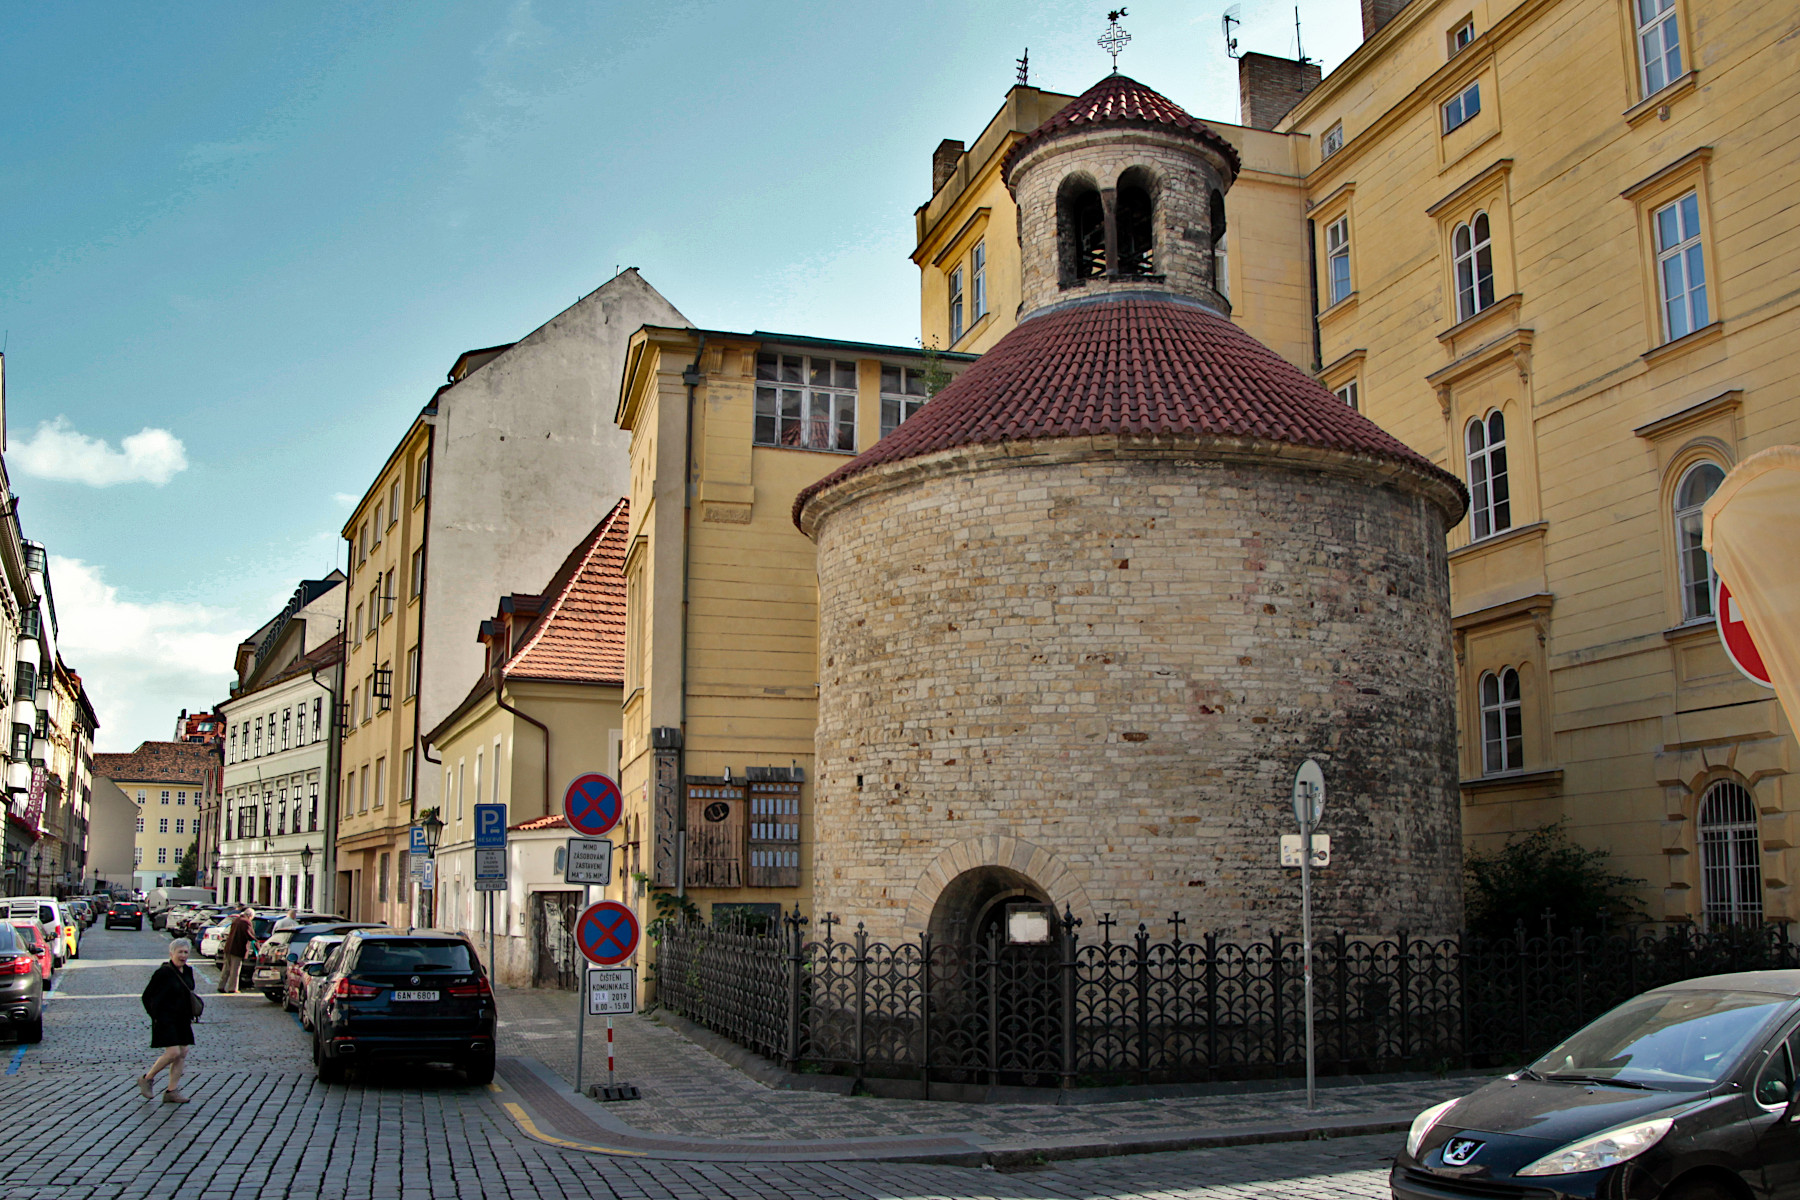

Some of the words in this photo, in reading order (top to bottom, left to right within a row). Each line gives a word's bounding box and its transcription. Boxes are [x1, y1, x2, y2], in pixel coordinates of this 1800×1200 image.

[26, 775, 40, 818] BOLOGNA
[482, 810, 499, 834] P
[414, 830, 424, 846] P
[425, 863, 432, 880] P
[600, 973, 621, 981] ČIŠTĚNÍ
[593, 983, 629, 991] KOMUNIKACE
[612, 993, 627, 1001] 2019
